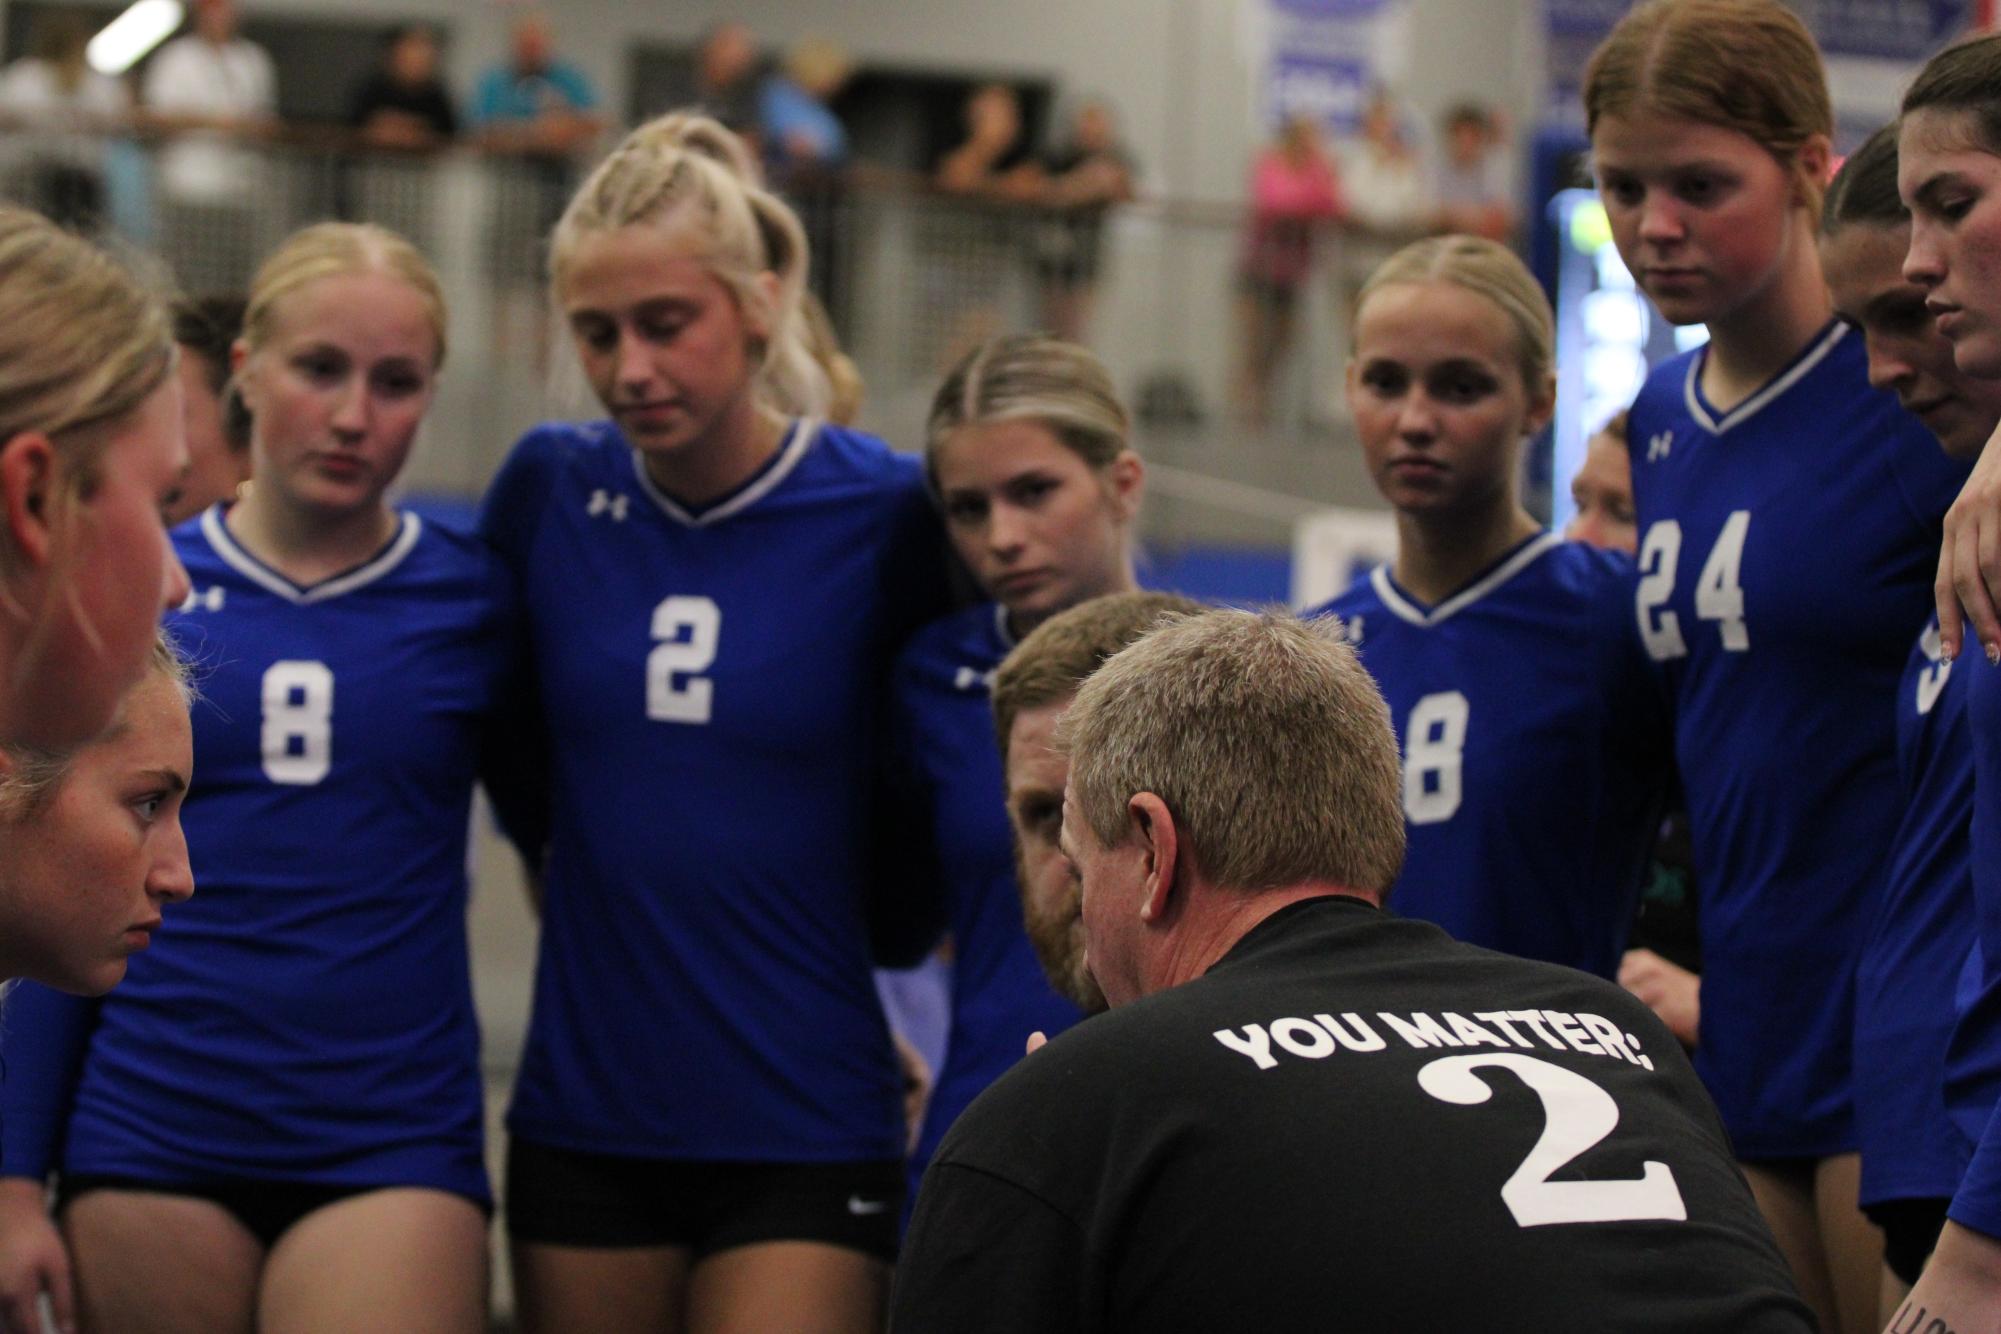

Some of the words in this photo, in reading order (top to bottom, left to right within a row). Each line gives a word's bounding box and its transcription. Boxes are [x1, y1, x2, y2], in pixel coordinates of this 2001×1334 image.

[1636, 510, 1750, 661] 24
[261, 660, 333, 785] 8
[646, 595, 721, 724] 2
[1403, 690, 1469, 825] 8
[1213, 1012, 1387, 1070] YOU
[1417, 1052, 1688, 1228] 2
